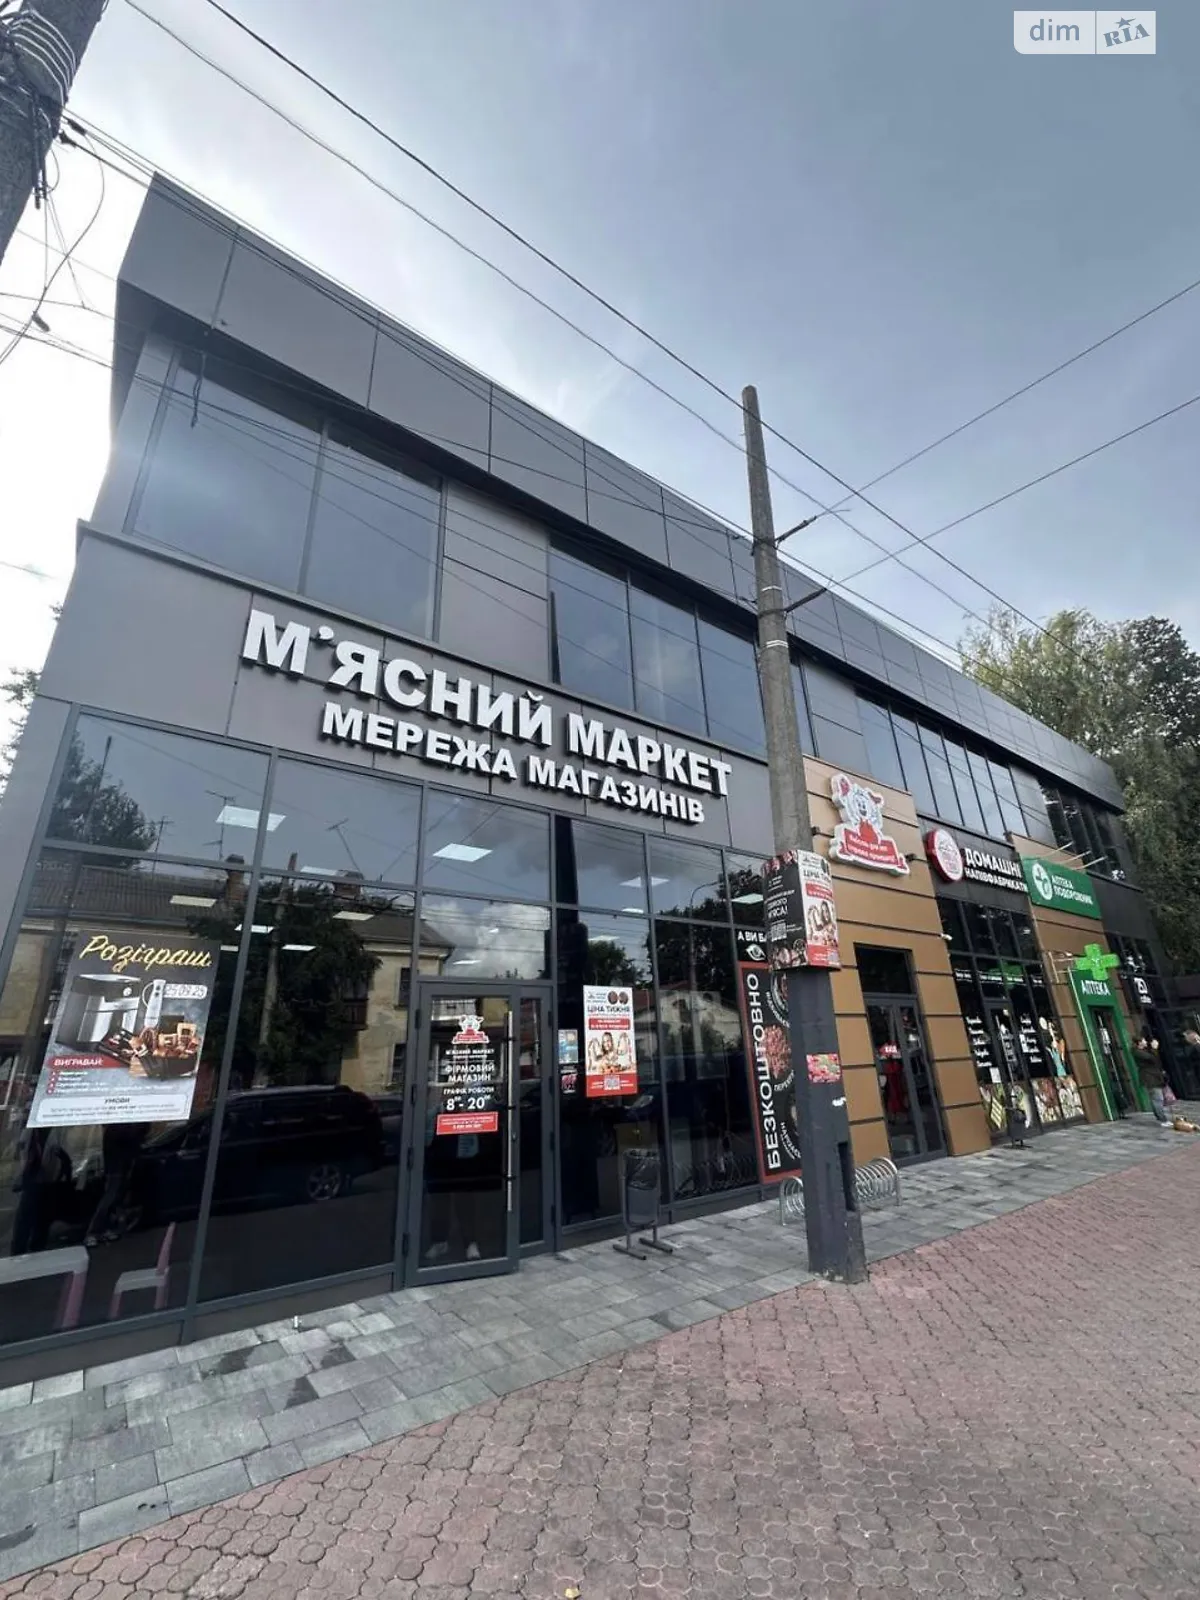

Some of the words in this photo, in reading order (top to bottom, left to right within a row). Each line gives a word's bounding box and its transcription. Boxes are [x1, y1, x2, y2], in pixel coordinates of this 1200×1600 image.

[241, 609, 553, 747] М'ЯСНИЙ
[566, 713, 733, 797] МАРКЕТ
[321, 702, 519, 780] МЕРЕЖА
[526, 754, 706, 825] МАГАЗИНІВ
[963, 847, 1022, 878] ДОМАШНІ
[737, 930, 745, 941] А
[79, 935, 214, 973] Розіграш
[1081, 980, 1111, 996] АПТЕКА
[445, 1062, 495, 1073] ФІРМОВИЙ
[448, 1074, 491, 1082] МАГАЗИН
[746, 973, 781, 1169] БЕЗКОШТОВНО
[469, 1087, 494, 1095] РОБОТИ
